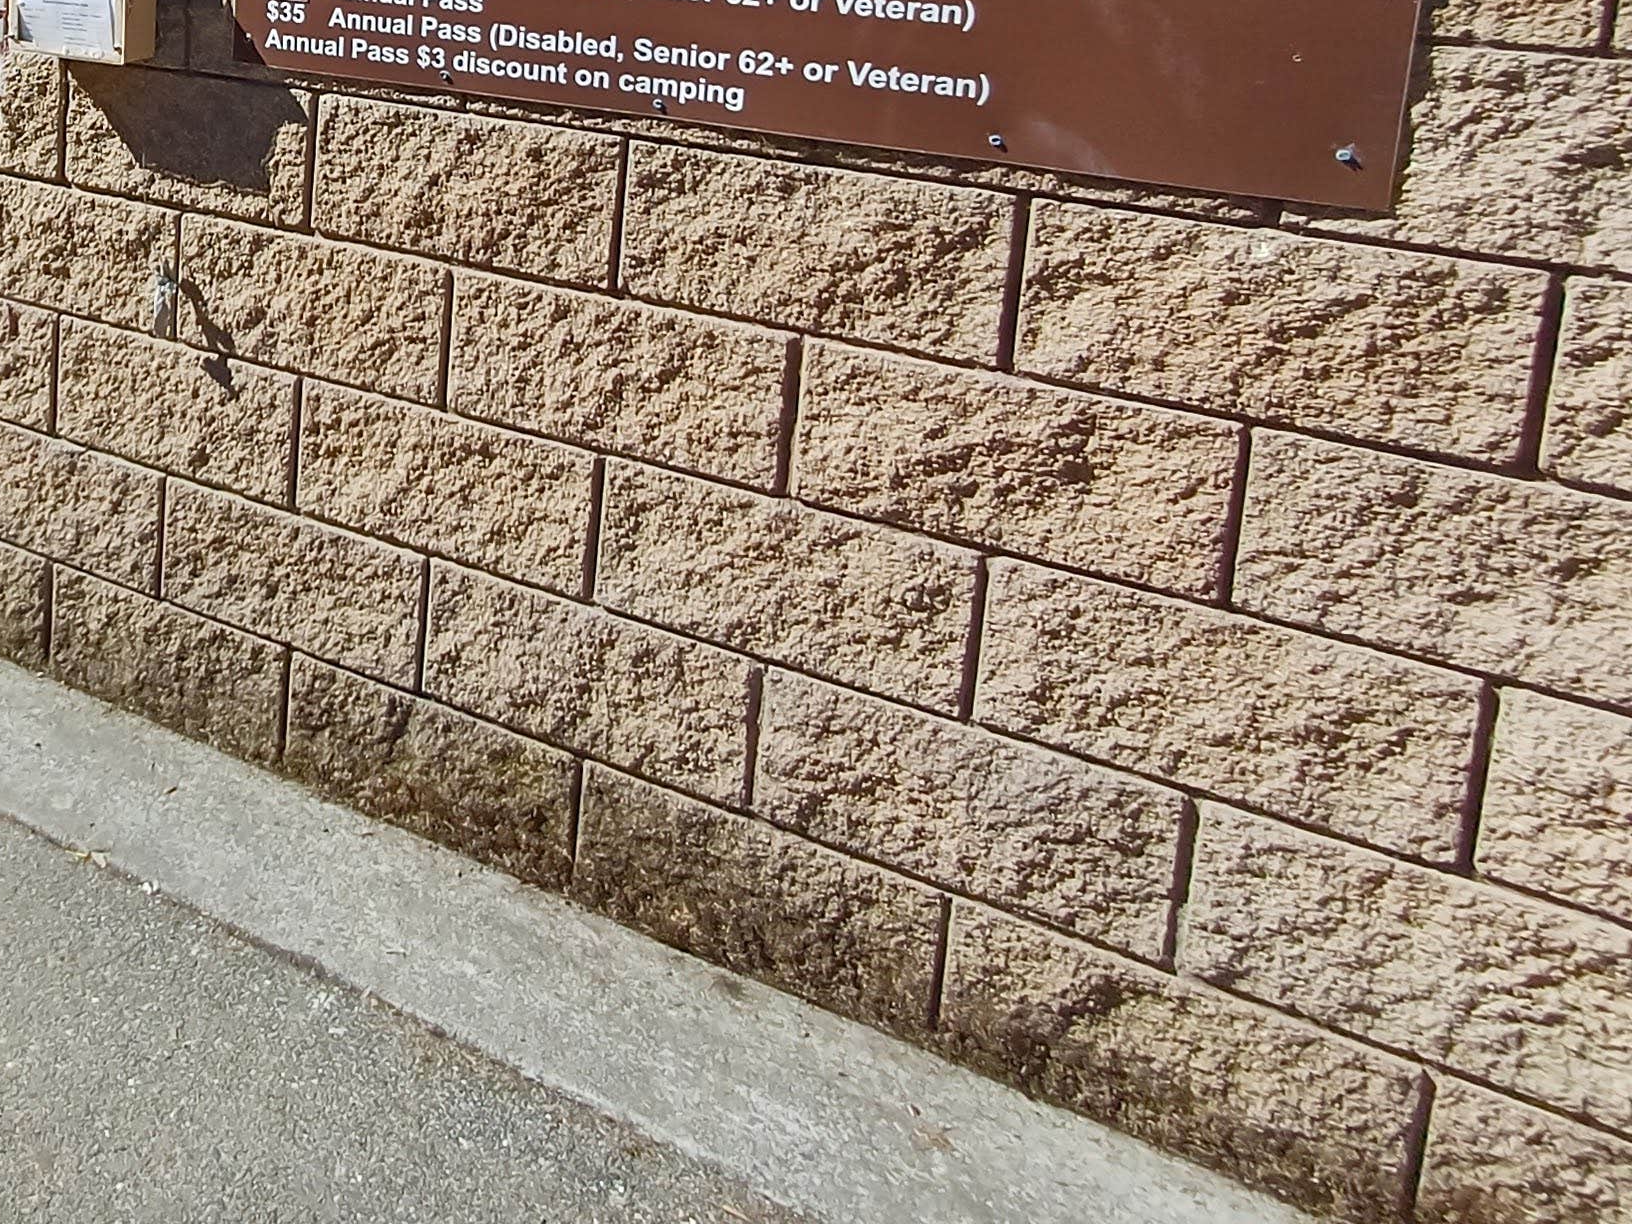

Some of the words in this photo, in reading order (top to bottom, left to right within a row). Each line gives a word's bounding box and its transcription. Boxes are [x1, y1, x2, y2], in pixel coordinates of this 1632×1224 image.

[265, 28, 344, 56] Annual
[352, 38, 409, 64] Pass
[417, 45, 444, 68] $3
[453, 50, 567, 84] discount
[575, 70, 609, 88] on
[619, 74, 744, 111] camping
[267, 0, 304, 23] $35
[328, 8, 413, 35] Annual
[421, 16, 481, 42] Pass
[490, 24, 623, 62] (Disabled,
[634, 38, 730, 70] Senior
[739, 50, 794, 76] 62+
[804, 63, 838, 82] or
[848, 60, 990, 106] Veteran)
